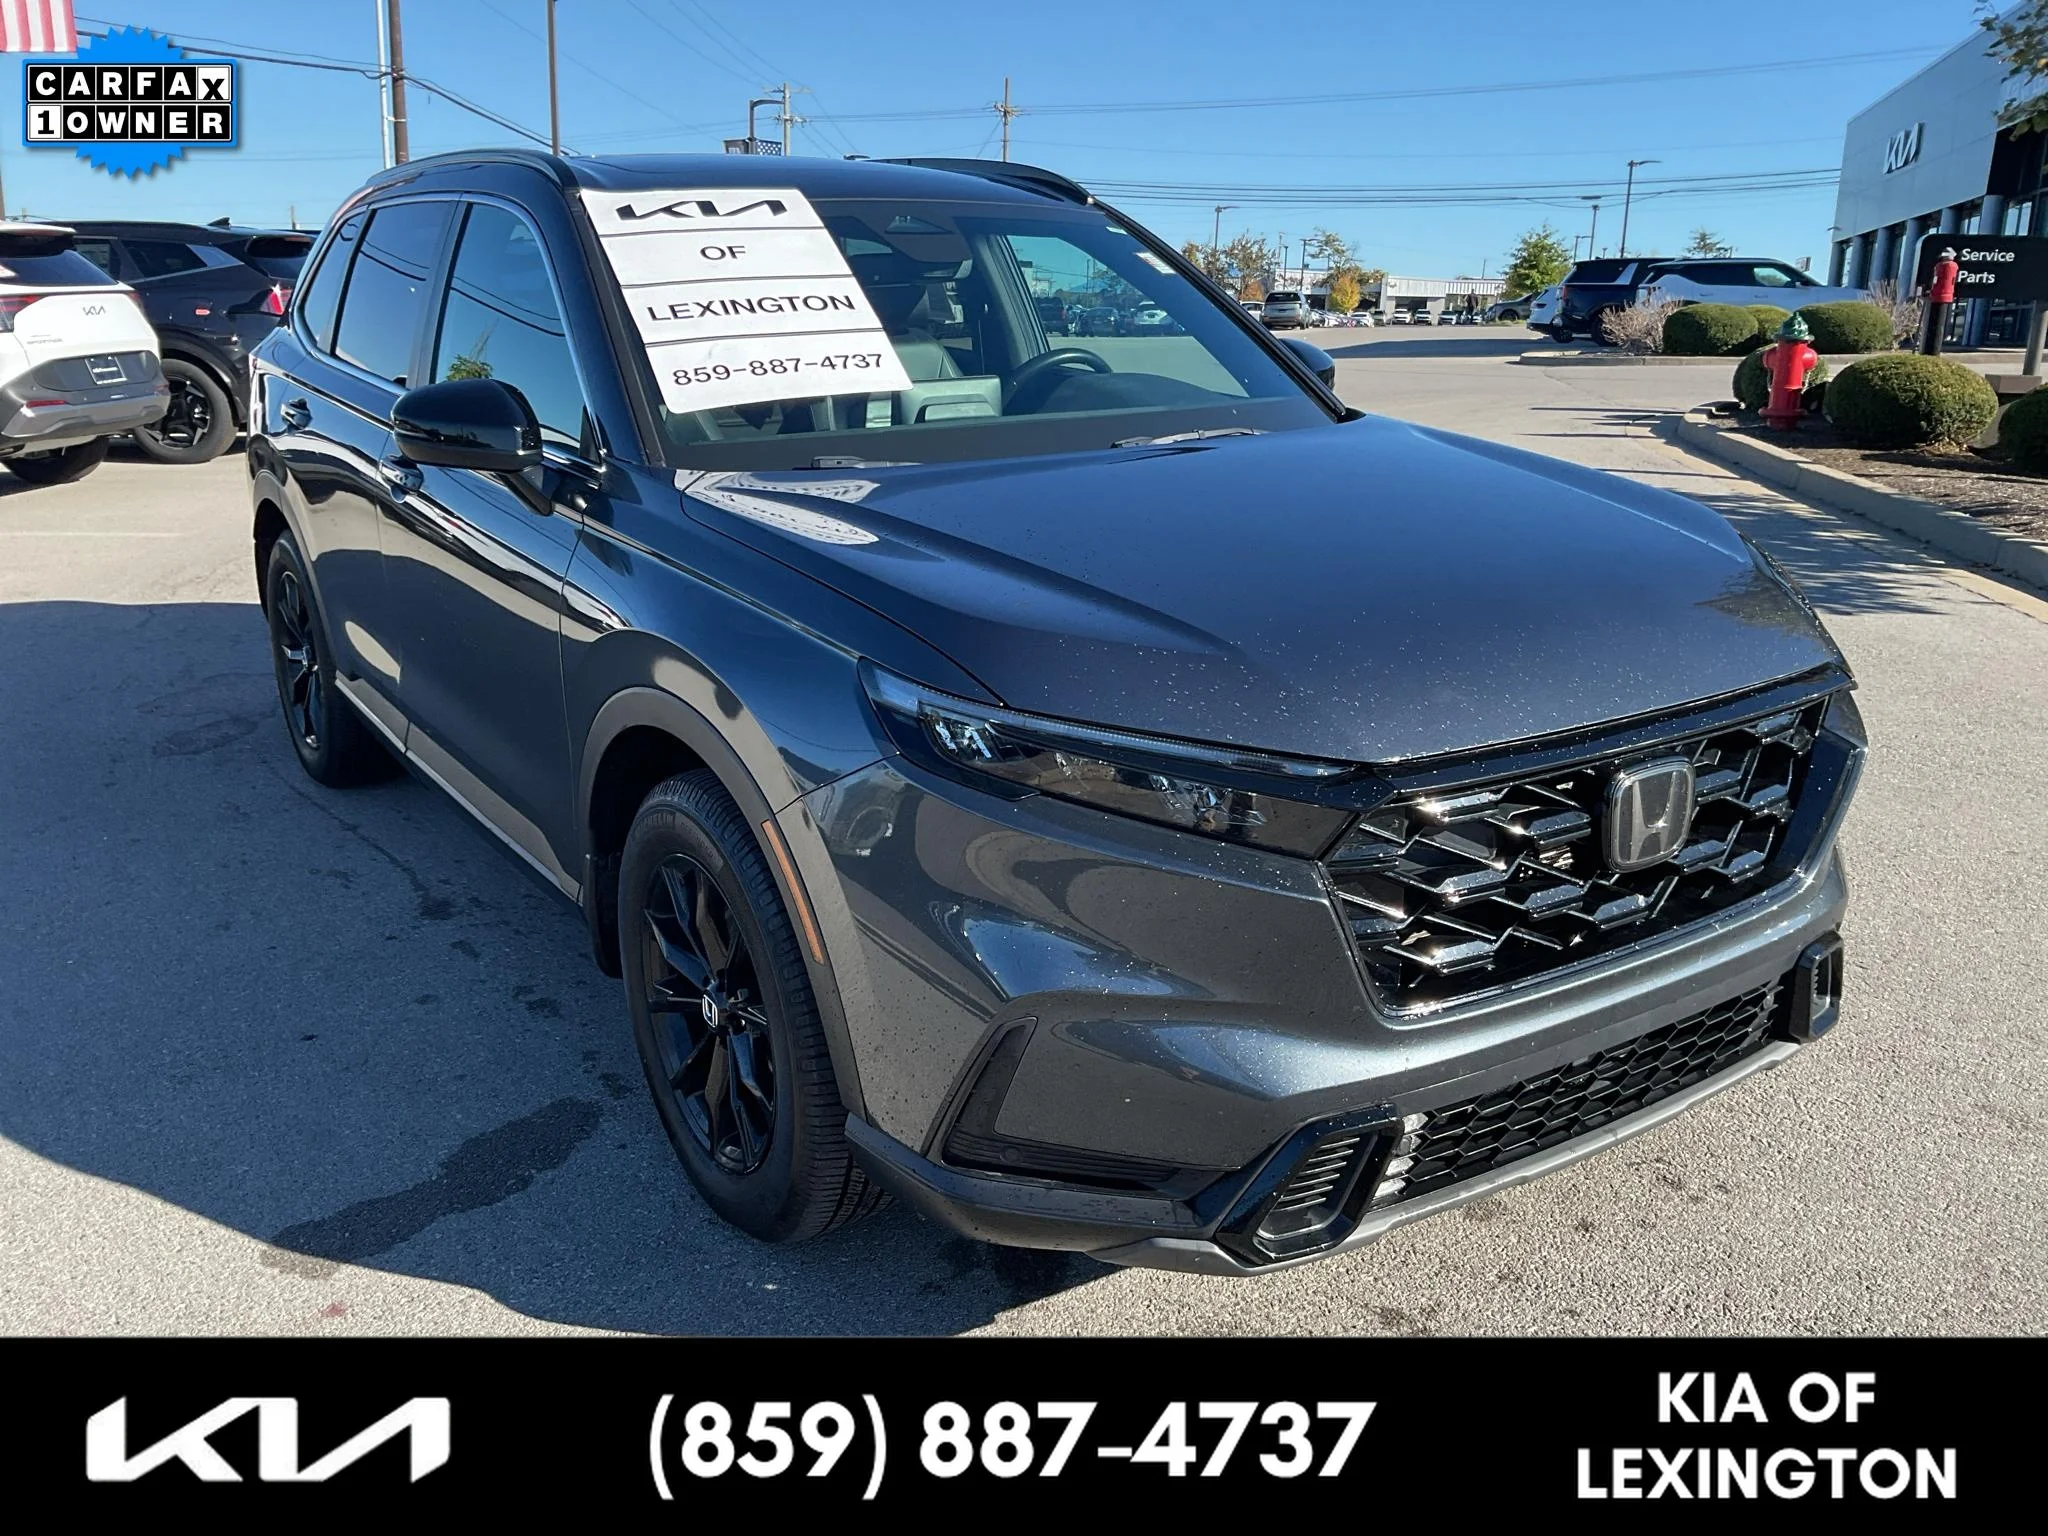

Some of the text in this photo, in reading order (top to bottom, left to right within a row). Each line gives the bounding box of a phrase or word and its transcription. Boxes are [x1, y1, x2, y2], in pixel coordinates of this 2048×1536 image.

[1883, 122, 1920, 174] KIA
[615, 200, 787, 221] KIA
[700, 245, 746, 260] OF
[1961, 248, 2015, 262] Service
[1957, 270, 1996, 284] Parts
[647, 294, 856, 322] LEXINGTON
[673, 353, 883, 386] 859-887-4737
